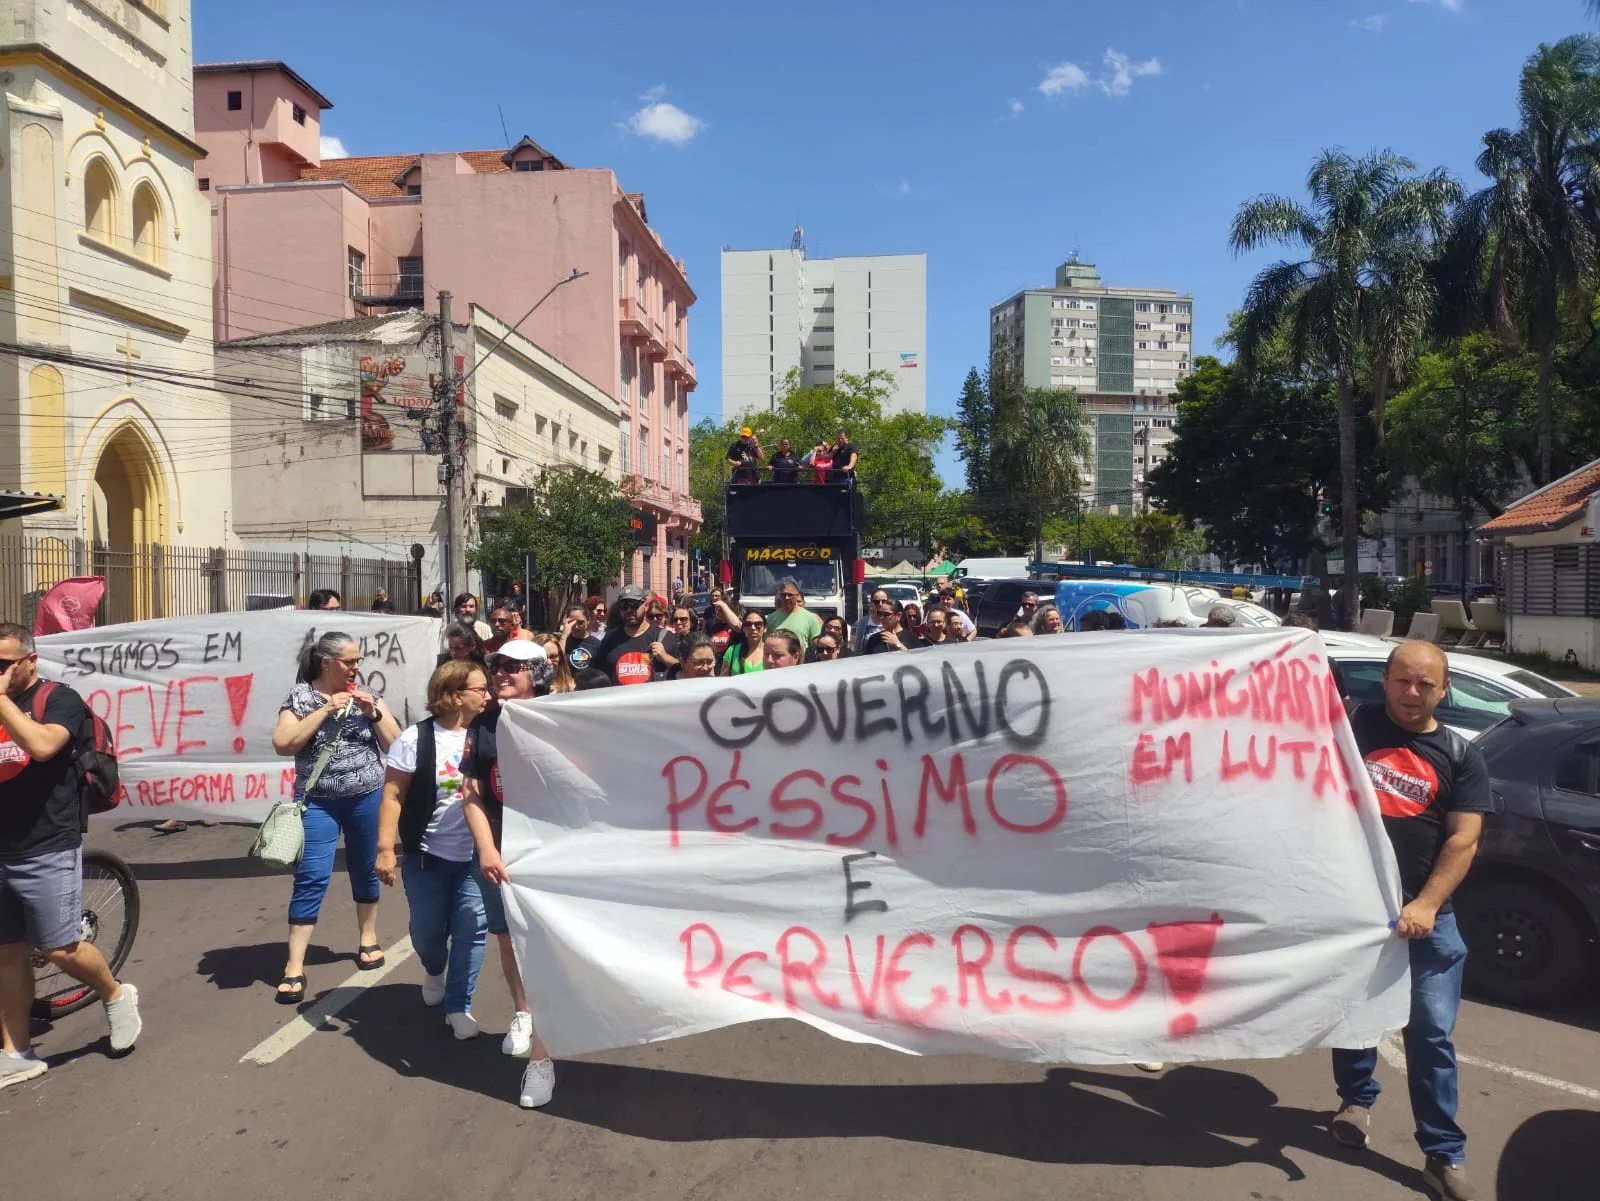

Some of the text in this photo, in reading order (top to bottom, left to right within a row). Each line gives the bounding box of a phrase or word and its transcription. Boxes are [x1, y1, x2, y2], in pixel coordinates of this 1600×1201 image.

[62, 631, 242, 677] ESTAMOS EM
[700, 659, 1051, 749] GOVERNO
[1130, 731, 1193, 785] EM
[137, 773, 236, 807] REFORMA
[245, 773, 268, 800] DA
[842, 850, 889, 922] E
[680, 911, 1224, 1038] PERVERSO!
